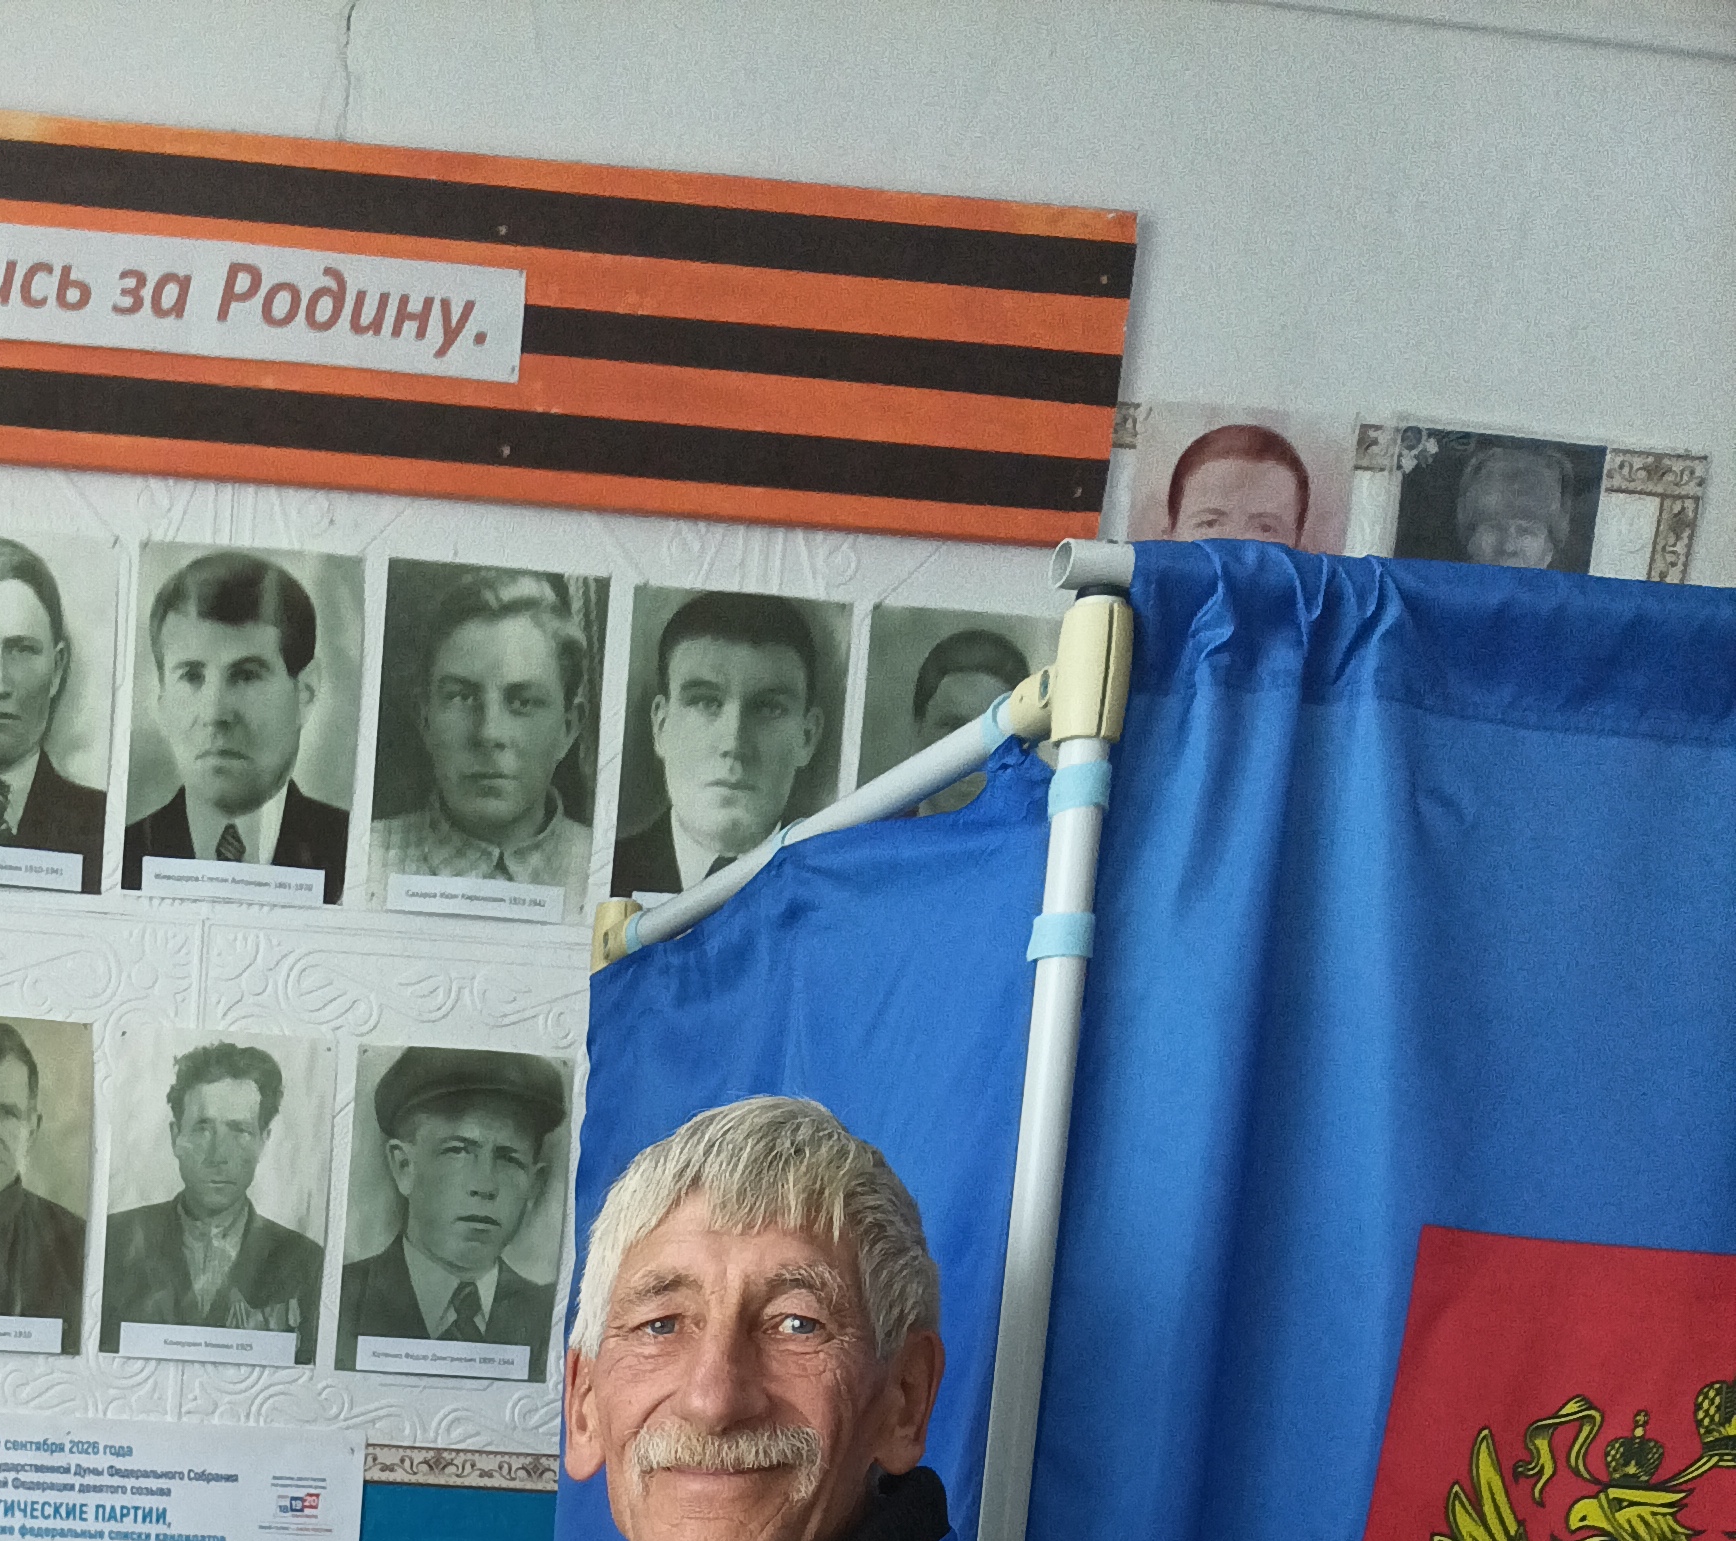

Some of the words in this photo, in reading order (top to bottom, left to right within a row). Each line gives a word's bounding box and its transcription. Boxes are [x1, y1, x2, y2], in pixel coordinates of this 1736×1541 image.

[111, 265, 192, 319] за
[217, 261, 488, 358] Родину.
[4, 1438, 65, 1456] сентября
[103, 1444, 134, 1459] года
[73, 1463, 105, 1479] Думы
[130, 1485, 172, 1498] созыва
[94, 1503, 172, 1529] ПАРТИИ,
